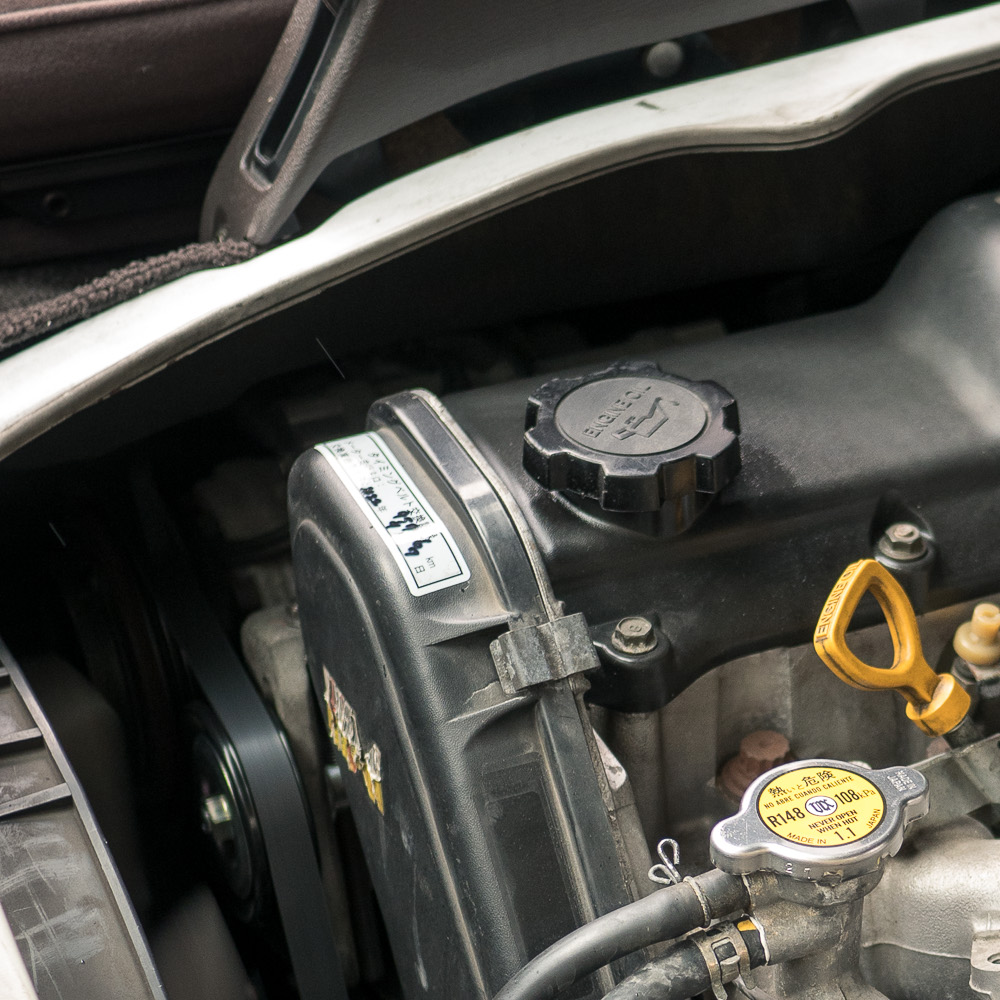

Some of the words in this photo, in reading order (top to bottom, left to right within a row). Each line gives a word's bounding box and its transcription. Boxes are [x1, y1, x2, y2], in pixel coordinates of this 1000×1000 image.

[582, 398, 633, 439] ENGINE
[414, 565, 426, 574] 日
[426, 556, 436, 569] km
[815, 582, 848, 639] ENGINE
[764, 800, 775, 810] NO
[776, 795, 795, 806] ABRE
[794, 786, 822, 800] CUANDO
[822, 775, 855, 790] CALIENTE
[768, 769, 837, 798] 熱いと危険
[767, 807, 806, 828] R148
[786, 832, 814, 845] MADE
[866, 808, 881, 829] JAPAN
[808, 816, 836, 830] NEVER
[835, 809, 858, 821] OPEN
[816, 823, 842, 834] WHEN
[842, 816, 859, 826] HOT
[834, 826, 857, 841] 1.1
